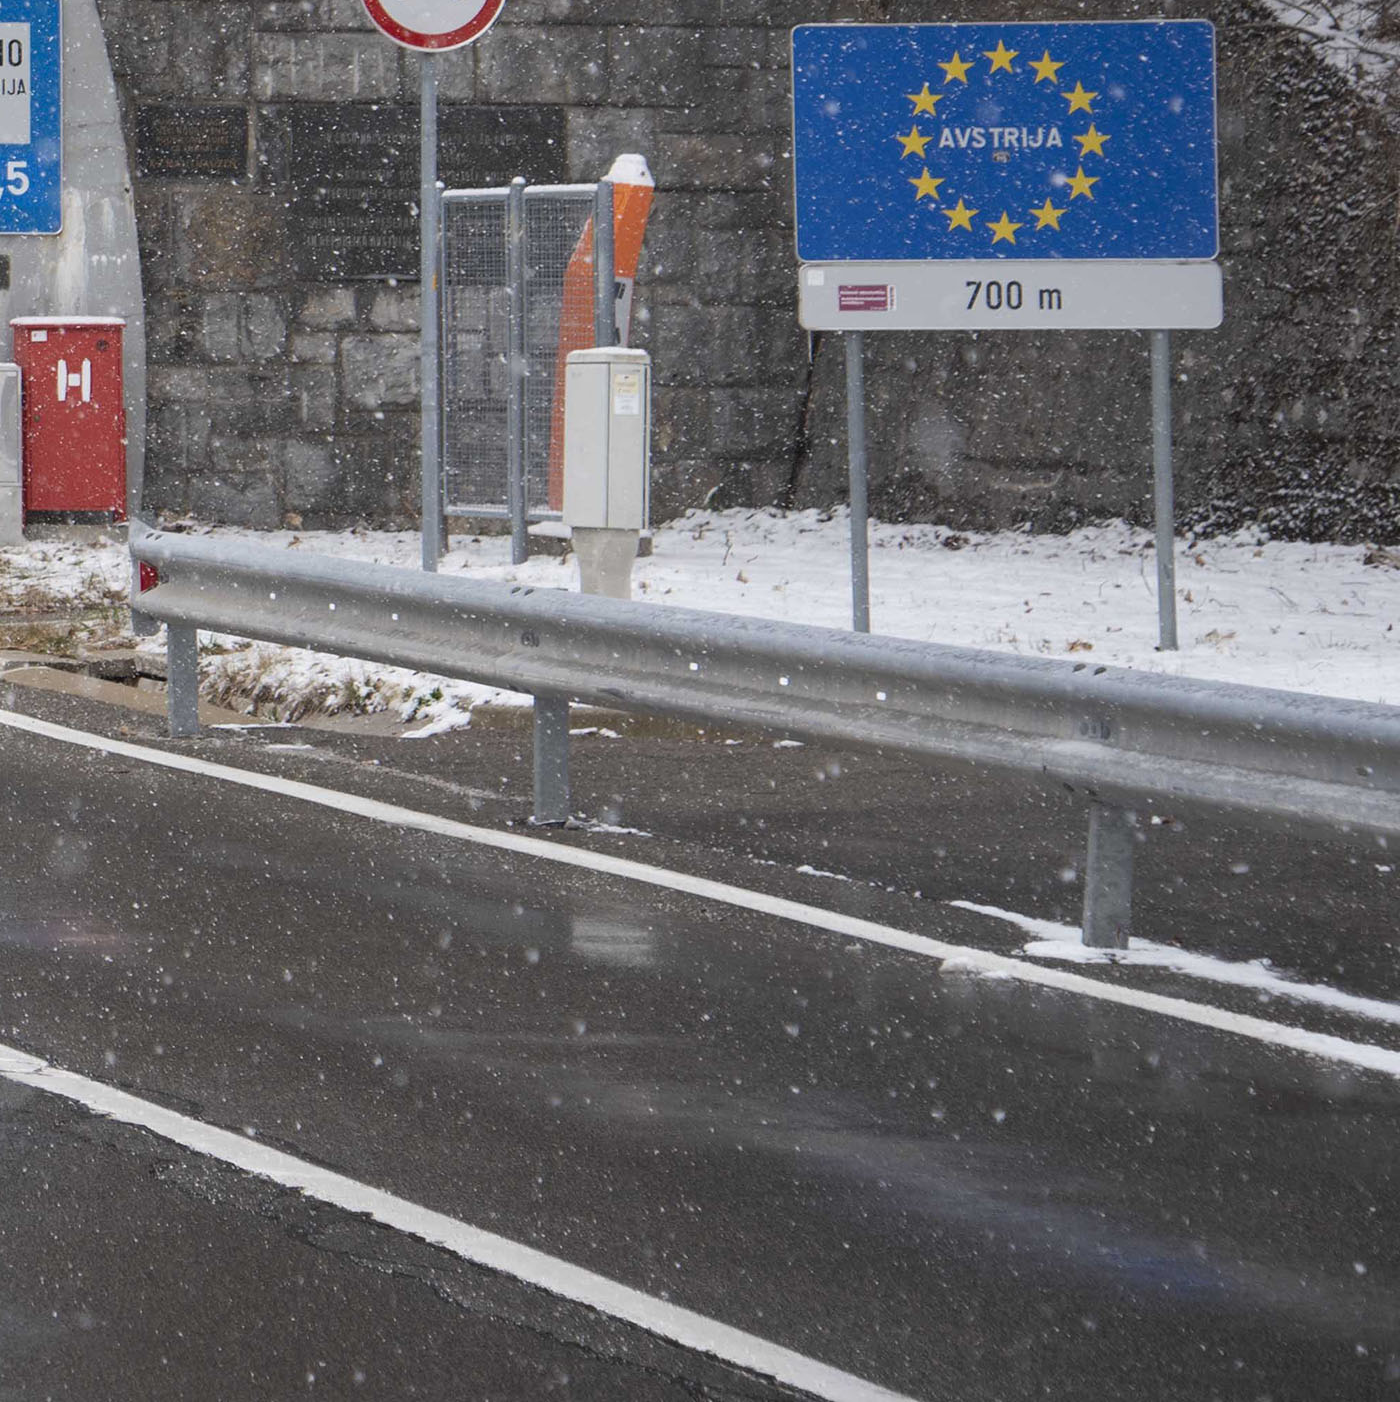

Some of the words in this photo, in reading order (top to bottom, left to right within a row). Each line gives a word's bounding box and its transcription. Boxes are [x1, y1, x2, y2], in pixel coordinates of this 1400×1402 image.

[938, 126, 1063, 149] AVSTRIJA
[966, 280, 1023, 310] 700
[1039, 288, 1062, 310] m
[56, 357, 92, 402] H
